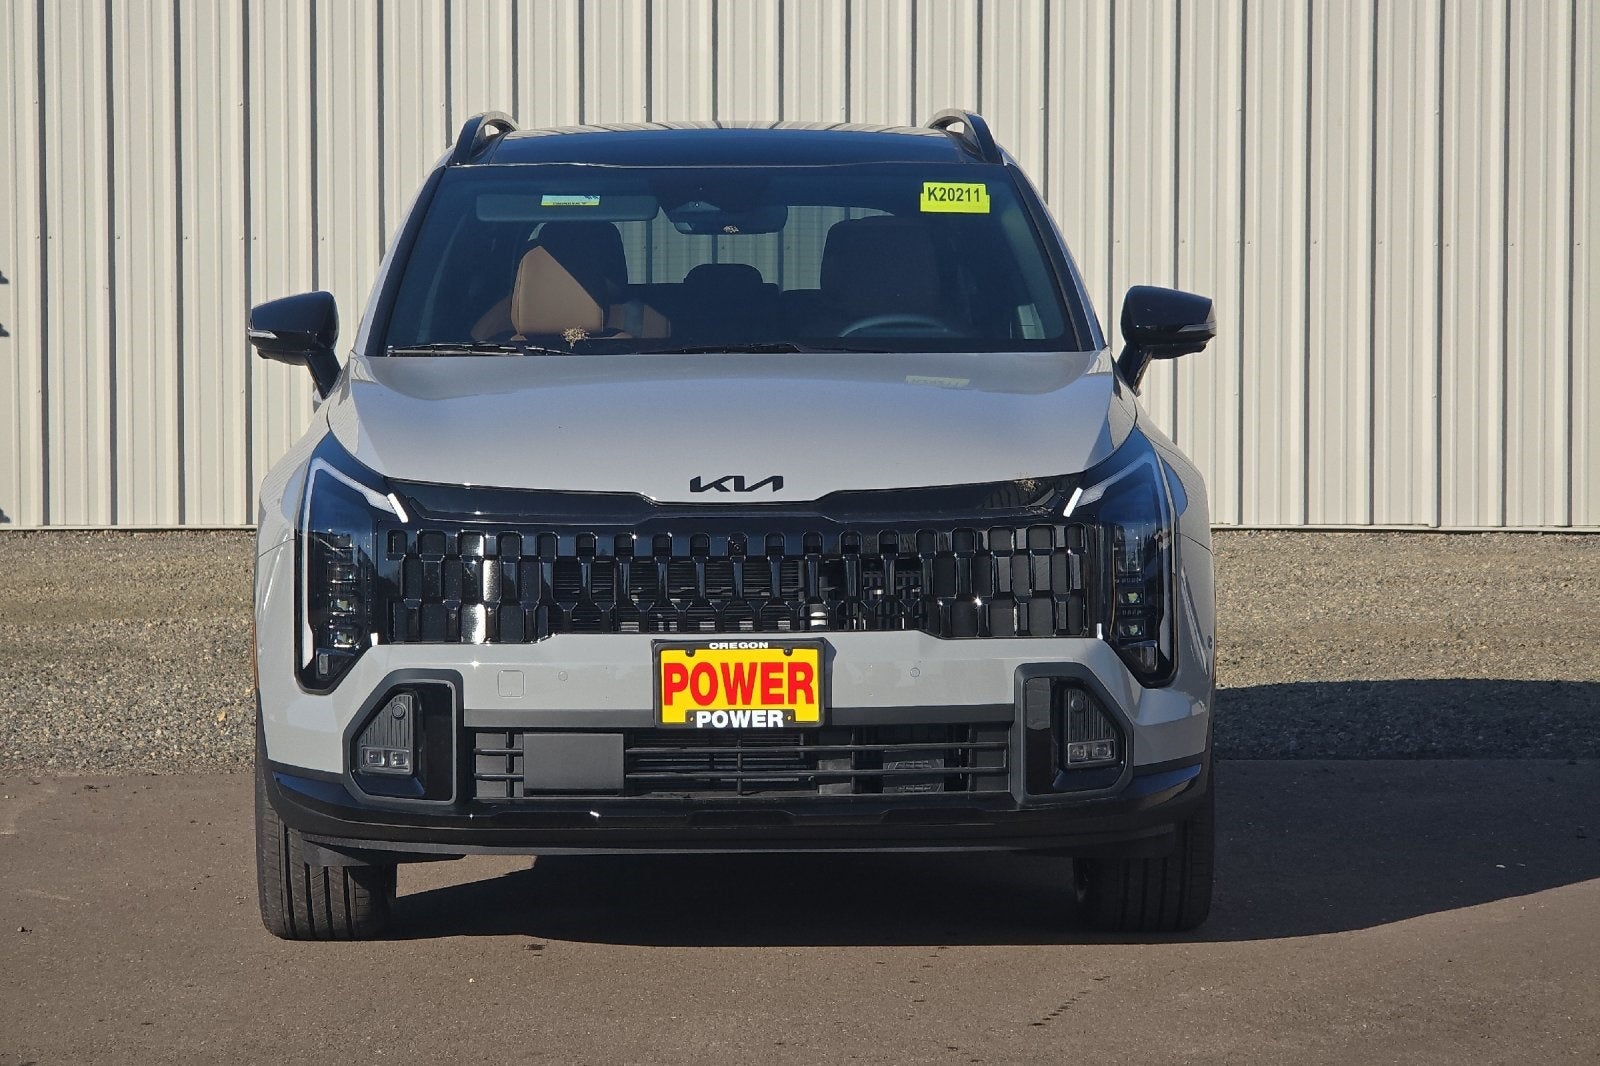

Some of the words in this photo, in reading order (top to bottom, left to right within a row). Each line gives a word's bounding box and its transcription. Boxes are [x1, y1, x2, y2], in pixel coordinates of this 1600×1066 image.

[928, 187, 980, 202] K20211
[690, 475, 784, 493] KIA
[708, 642, 769, 650] OREGON
[664, 661, 815, 706] POWER
[696, 710, 784, 728] POWER
